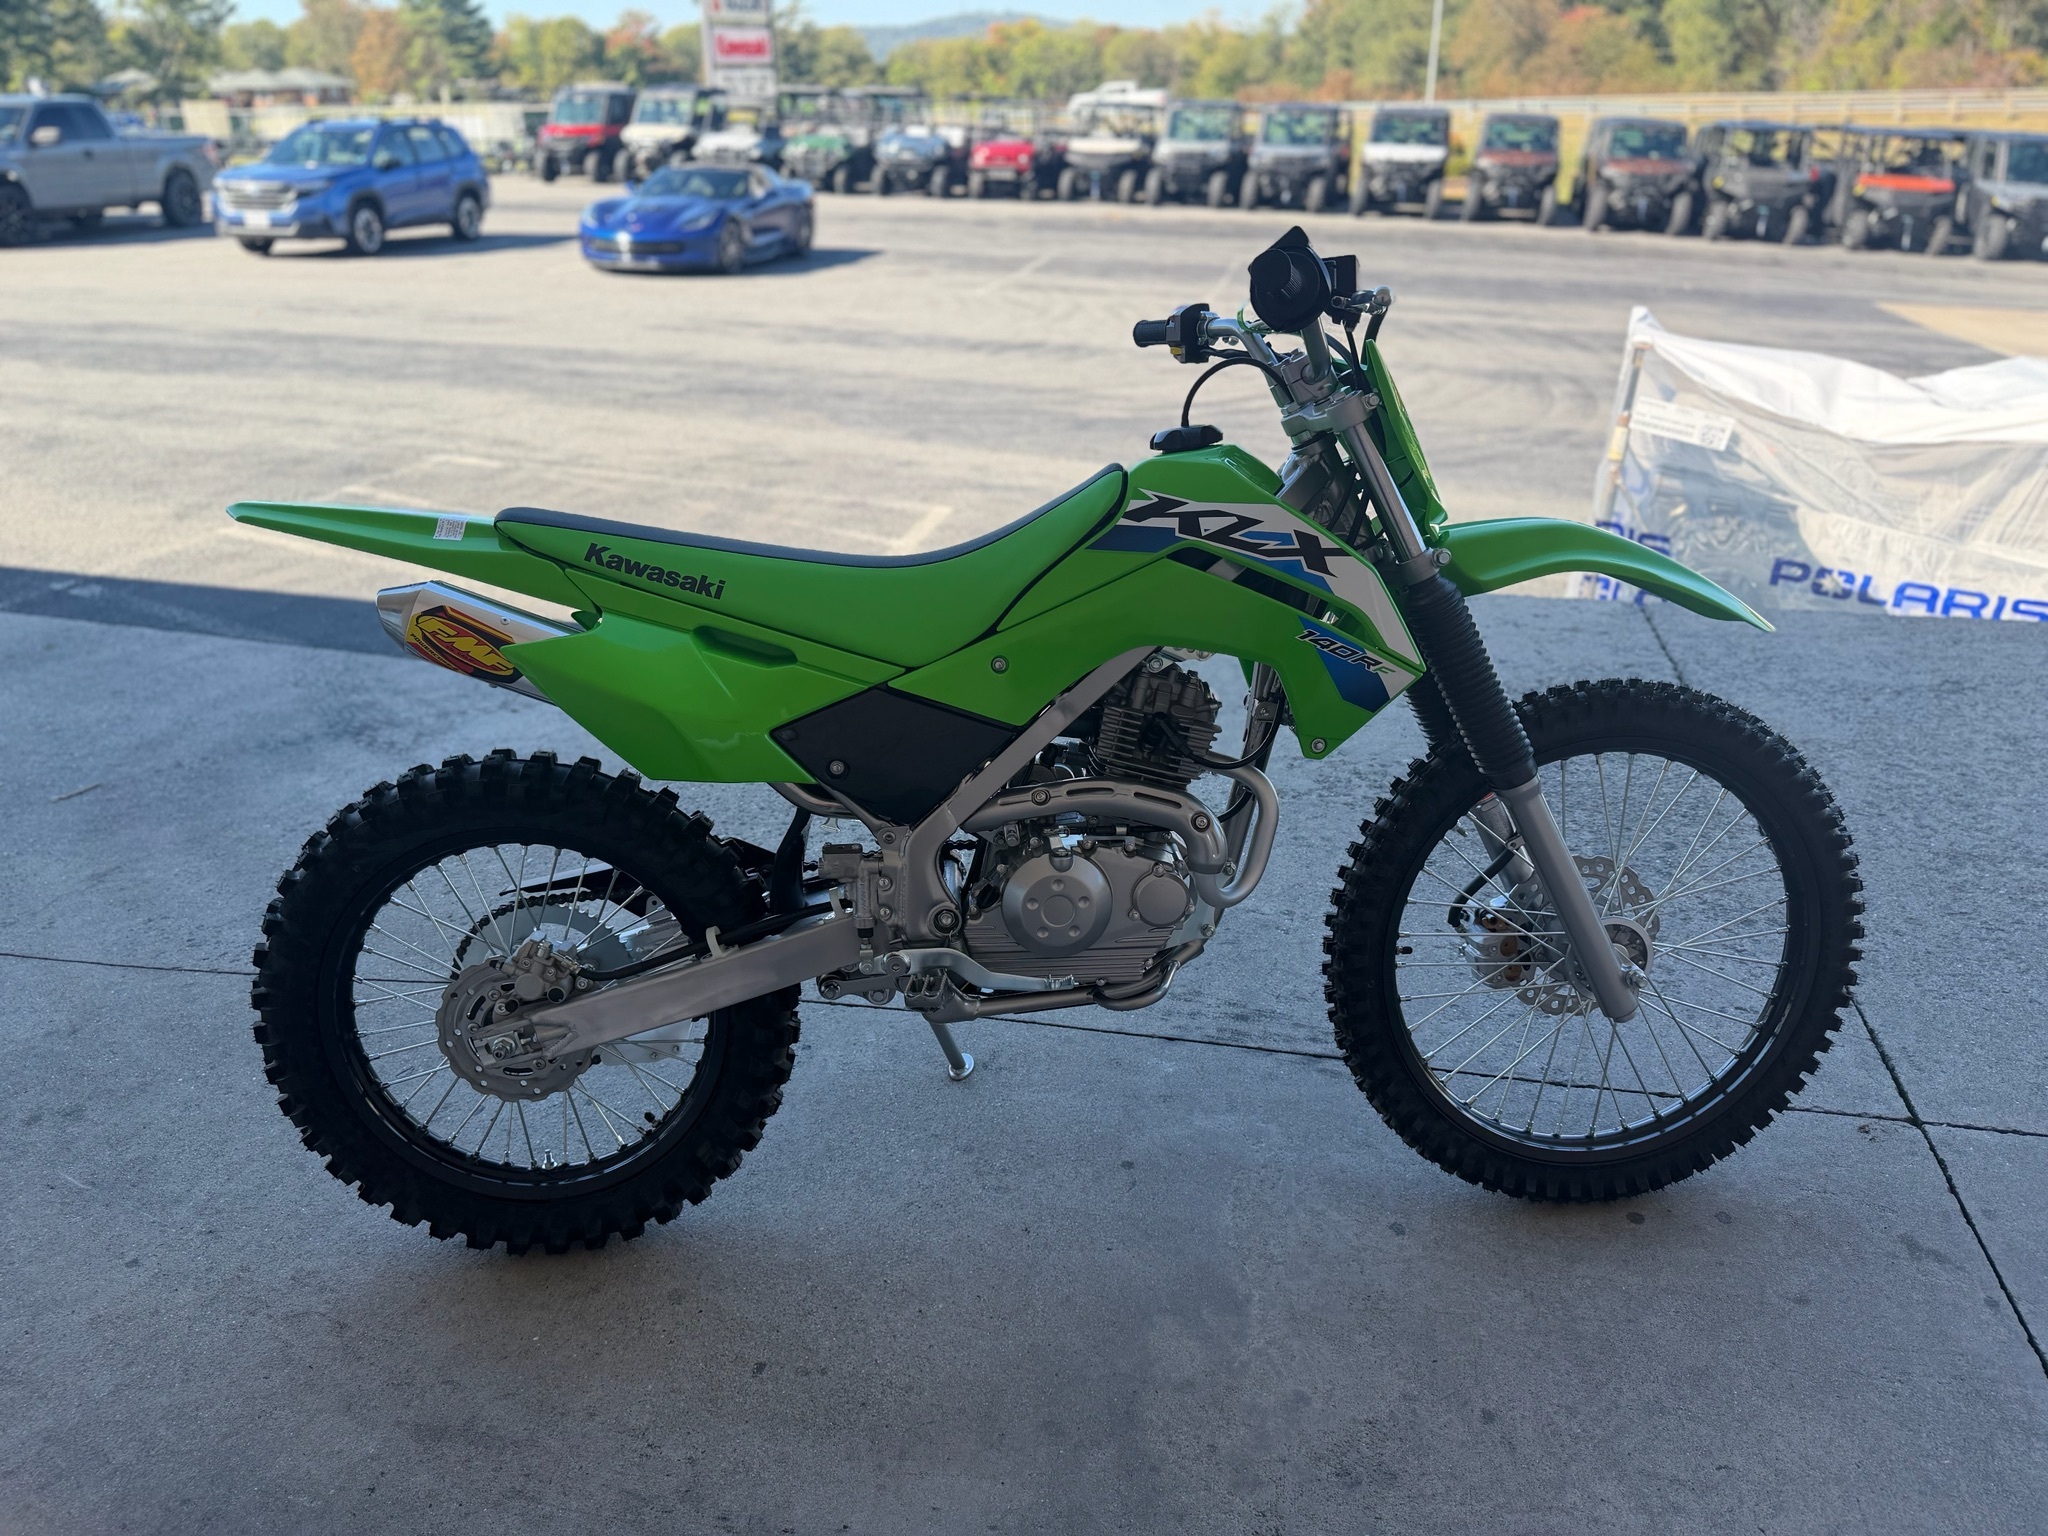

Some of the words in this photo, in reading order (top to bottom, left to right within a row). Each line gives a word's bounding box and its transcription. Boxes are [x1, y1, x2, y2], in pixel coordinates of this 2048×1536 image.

[1121, 490, 1353, 579] KLX
[583, 542, 726, 600] Kawasaki
[416, 618, 516, 672] FMF
[1296, 628, 1396, 676] 140RF
